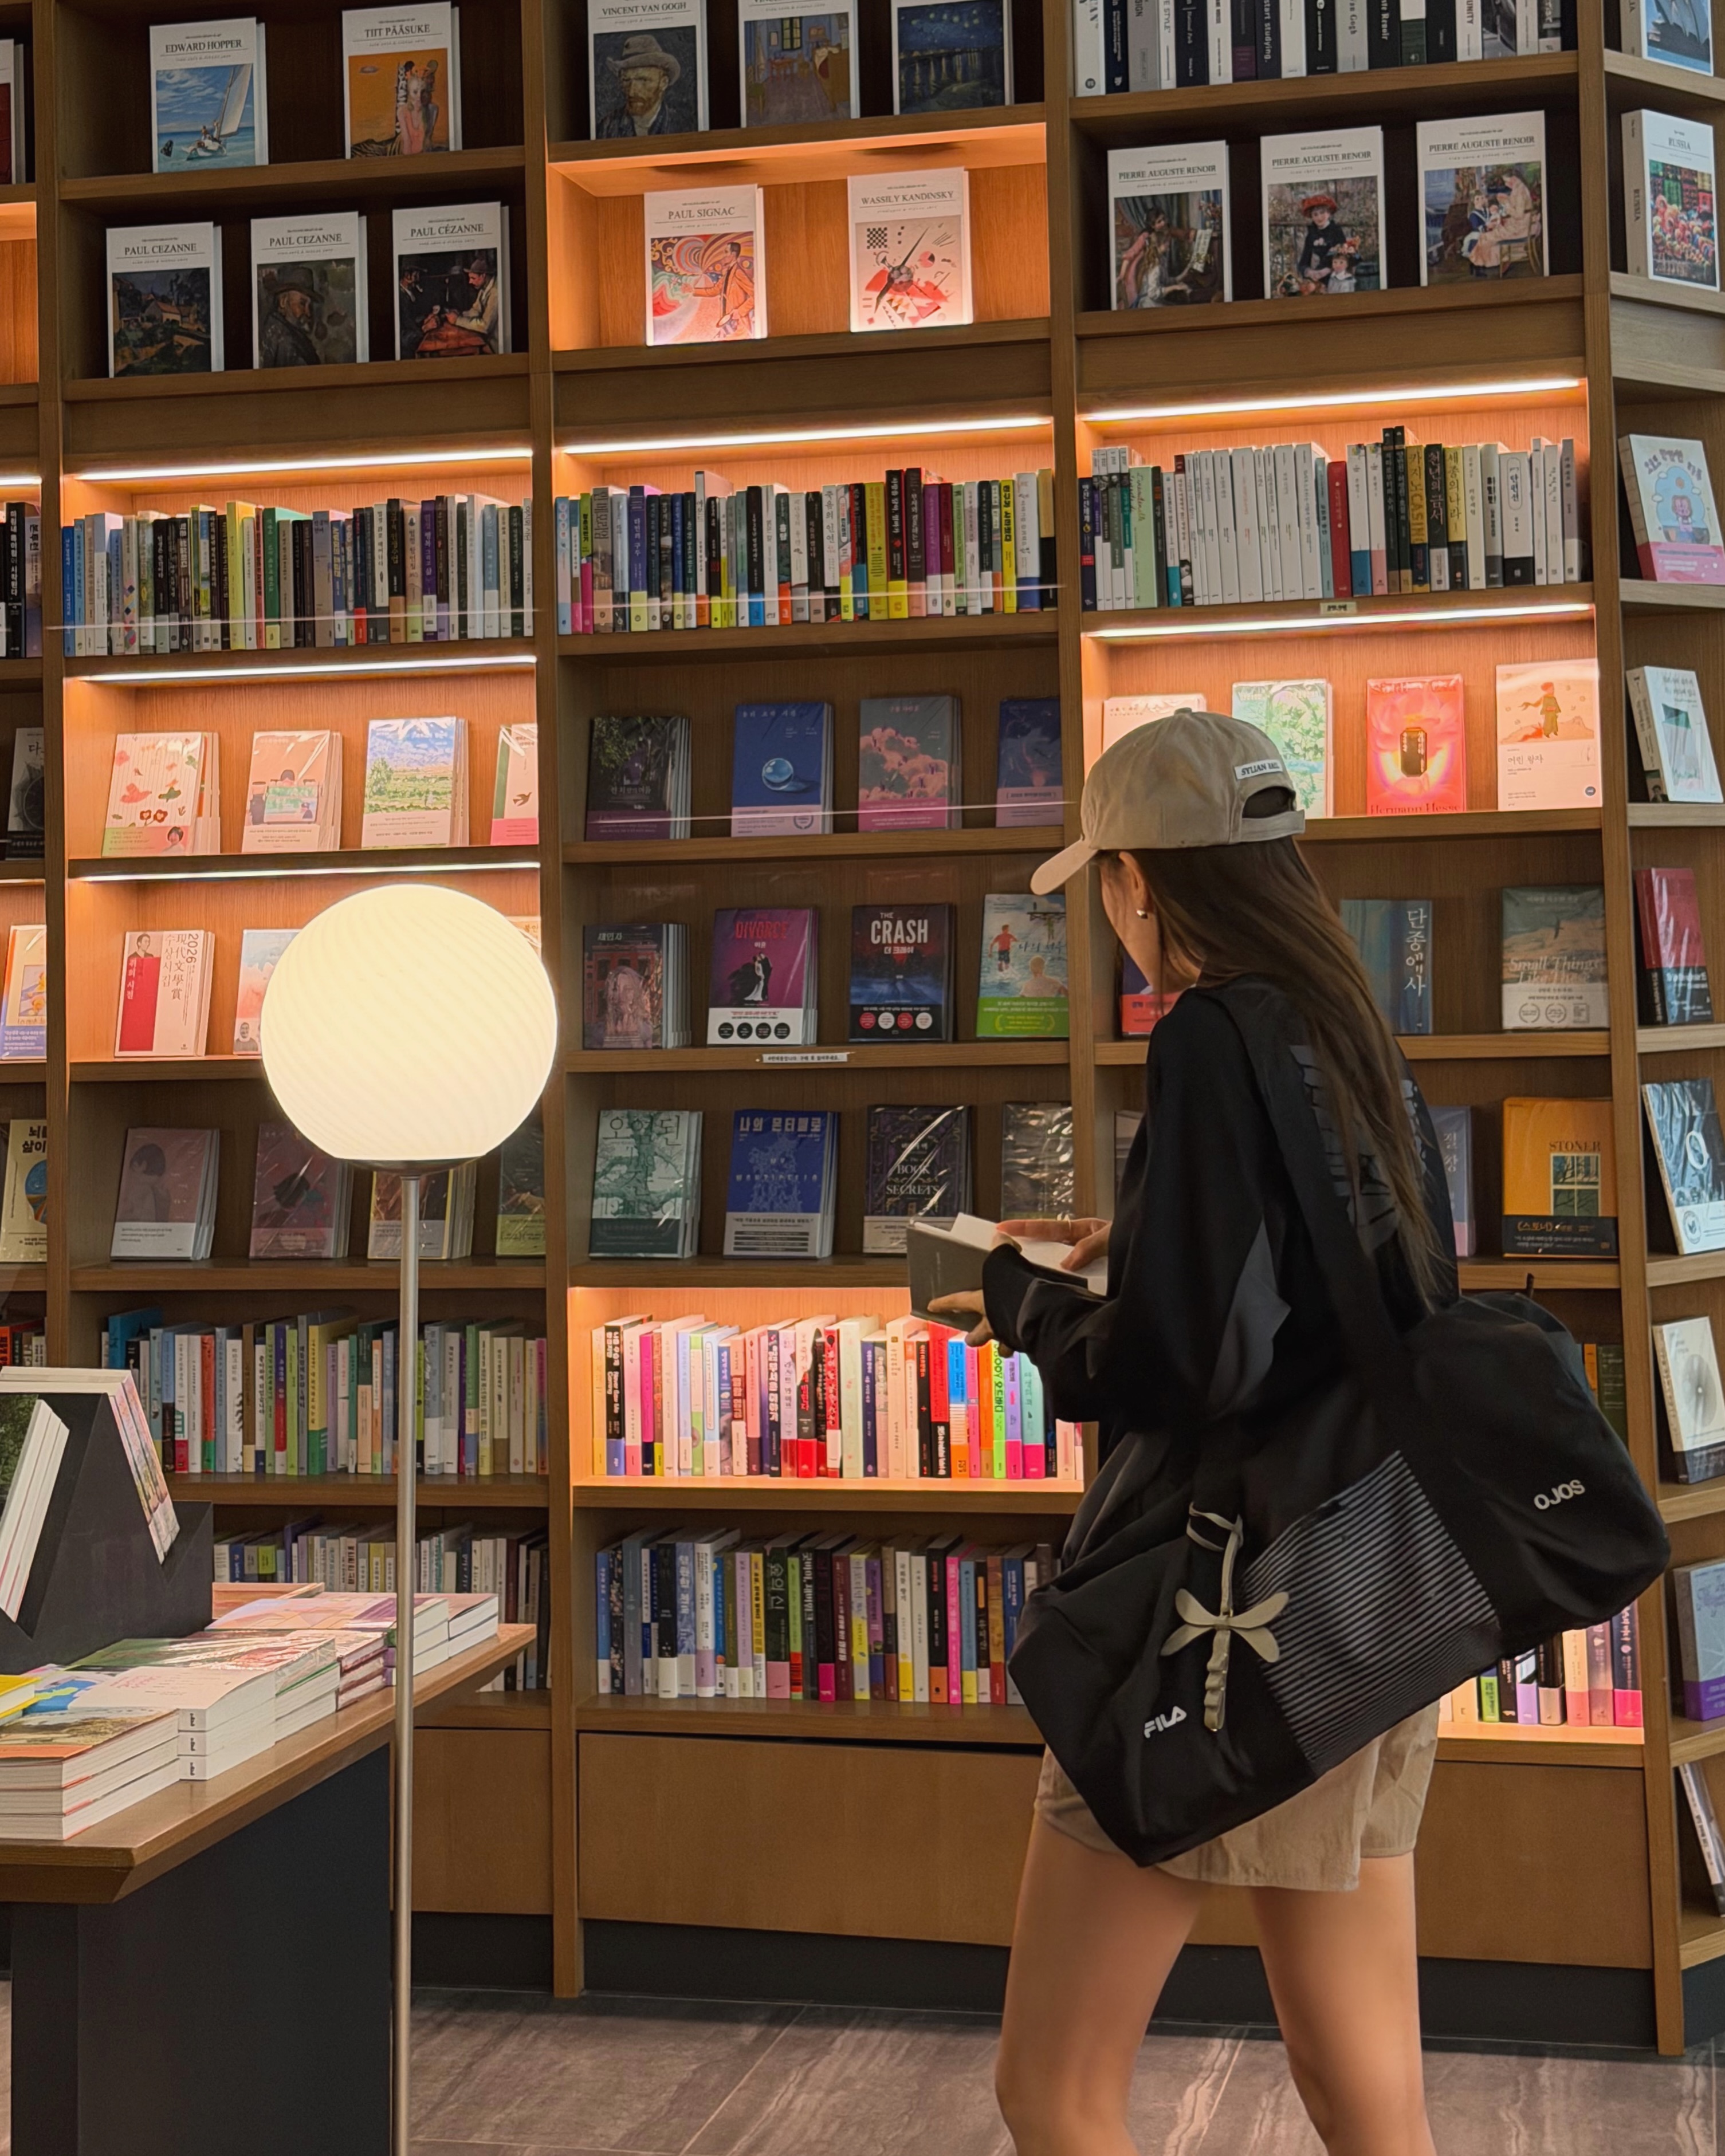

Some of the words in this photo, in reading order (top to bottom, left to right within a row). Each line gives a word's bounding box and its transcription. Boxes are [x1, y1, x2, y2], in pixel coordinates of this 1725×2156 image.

[602, 6, 639, 16] VINCENT
[642, 4, 660, 13] VAN
[661, 2, 687, 11] GOGH
[1381, 12, 1390, 41] Renoir
[165, 42, 206, 53] EDWARD
[207, 39, 242, 50] HOPPER
[1264, 22, 1272, 62] studying.
[1428, 142, 1459, 153] PIERRE
[1460, 139, 1501, 150] AUGUSTE
[1502, 135, 1535, 146] RENOIR
[1271, 156, 1300, 167] PIERRE
[1301, 154, 1341, 164] AUGUSTE
[1341, 150, 1372, 161] RENOIR
[1118, 170, 1145, 180] PIERRE
[1146, 168, 1185, 178] AUGUSTE
[1186, 164, 1217, 174] RENOIR
[860, 195, 901, 206] WASSILY
[901, 190, 954, 203] KANDINSKY
[668, 209, 695, 220] PAUL
[697, 206, 736, 218] SIGNAC
[410, 227, 439, 238] PAUL
[269, 237, 294, 247] PAUL
[124, 246, 150, 257] PAUL
[1428, 450, 1441, 492] 천년의
[1429, 494, 1443, 526] 금서
[1507, 755, 1524, 766] 어린
[1527, 754, 1544, 765] 왕자
[1370, 804, 1423, 815] Hermann
[1424, 802, 1461, 813] Hesse
[880, 912, 894, 920] THE
[735, 920, 789, 940] DIVORCE
[870, 919, 929, 945] CRASH
[186, 933, 199, 964] 2026
[883, 947, 892, 955] 더
[1404, 908, 1428, 998] 단종애사
[160, 933, 175, 989] 수상시집
[1509, 957, 1548, 973] Small
[1551, 956, 1600, 973] Things
[28, 1126, 47, 1139] 뇌
[740, 1117, 764, 1132] 나의
[1549, 1140, 1602, 1153] STONER
[897, 1164, 930, 1174] BOOK
[886, 1183, 940, 1195] SECRETS
[1533, 1478, 1587, 1512] OJOS
[1142, 1703, 1188, 1740] FILA
